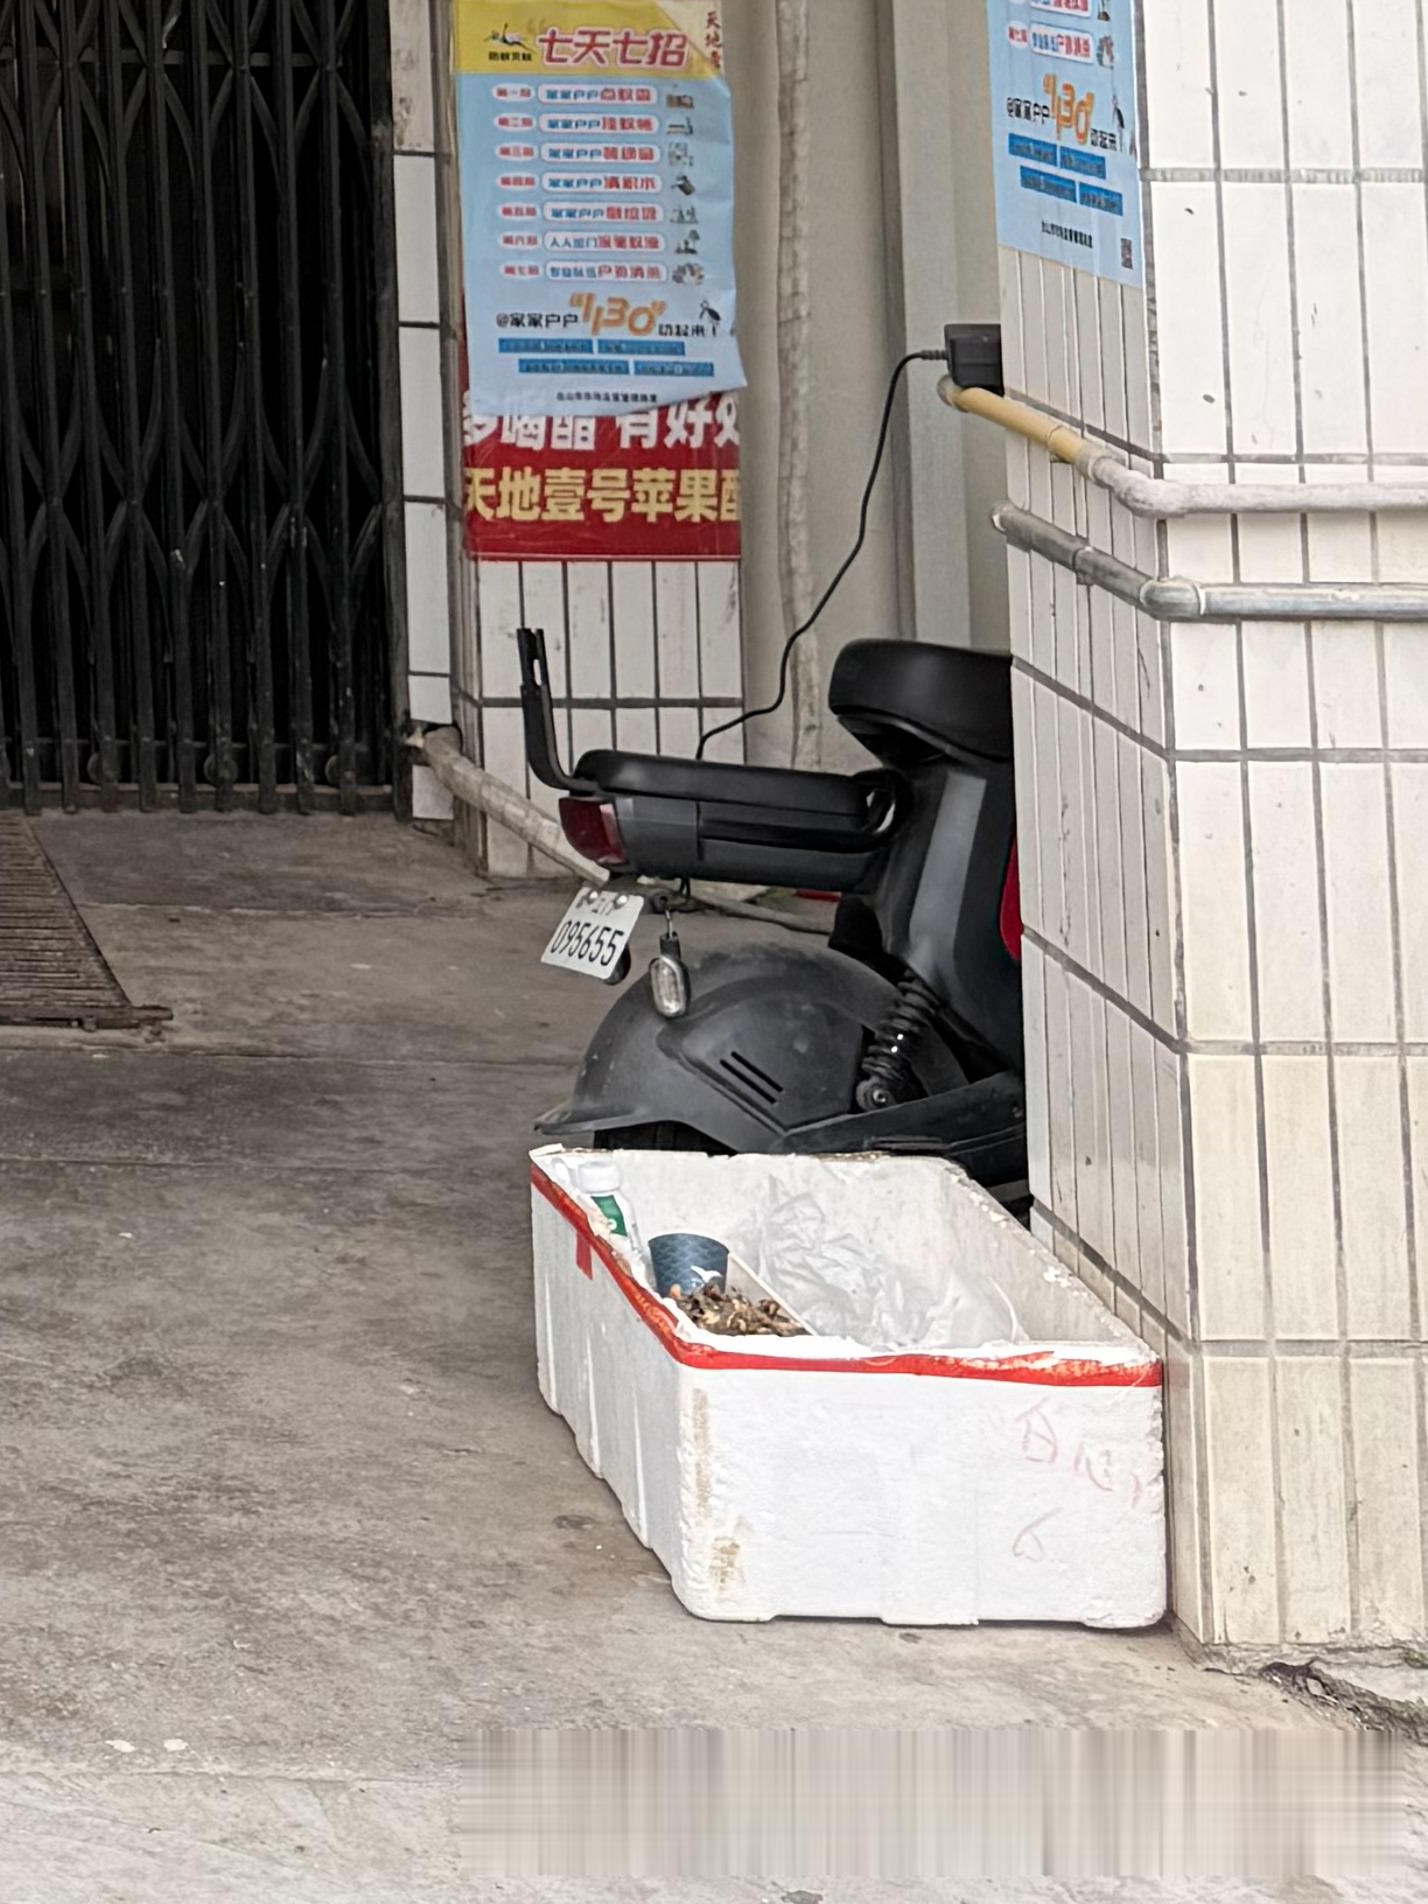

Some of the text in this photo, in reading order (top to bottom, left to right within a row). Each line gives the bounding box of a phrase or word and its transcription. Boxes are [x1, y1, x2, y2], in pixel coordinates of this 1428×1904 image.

[539, 28, 688, 67] 七天七招
[550, 918, 626, 967] 095655
